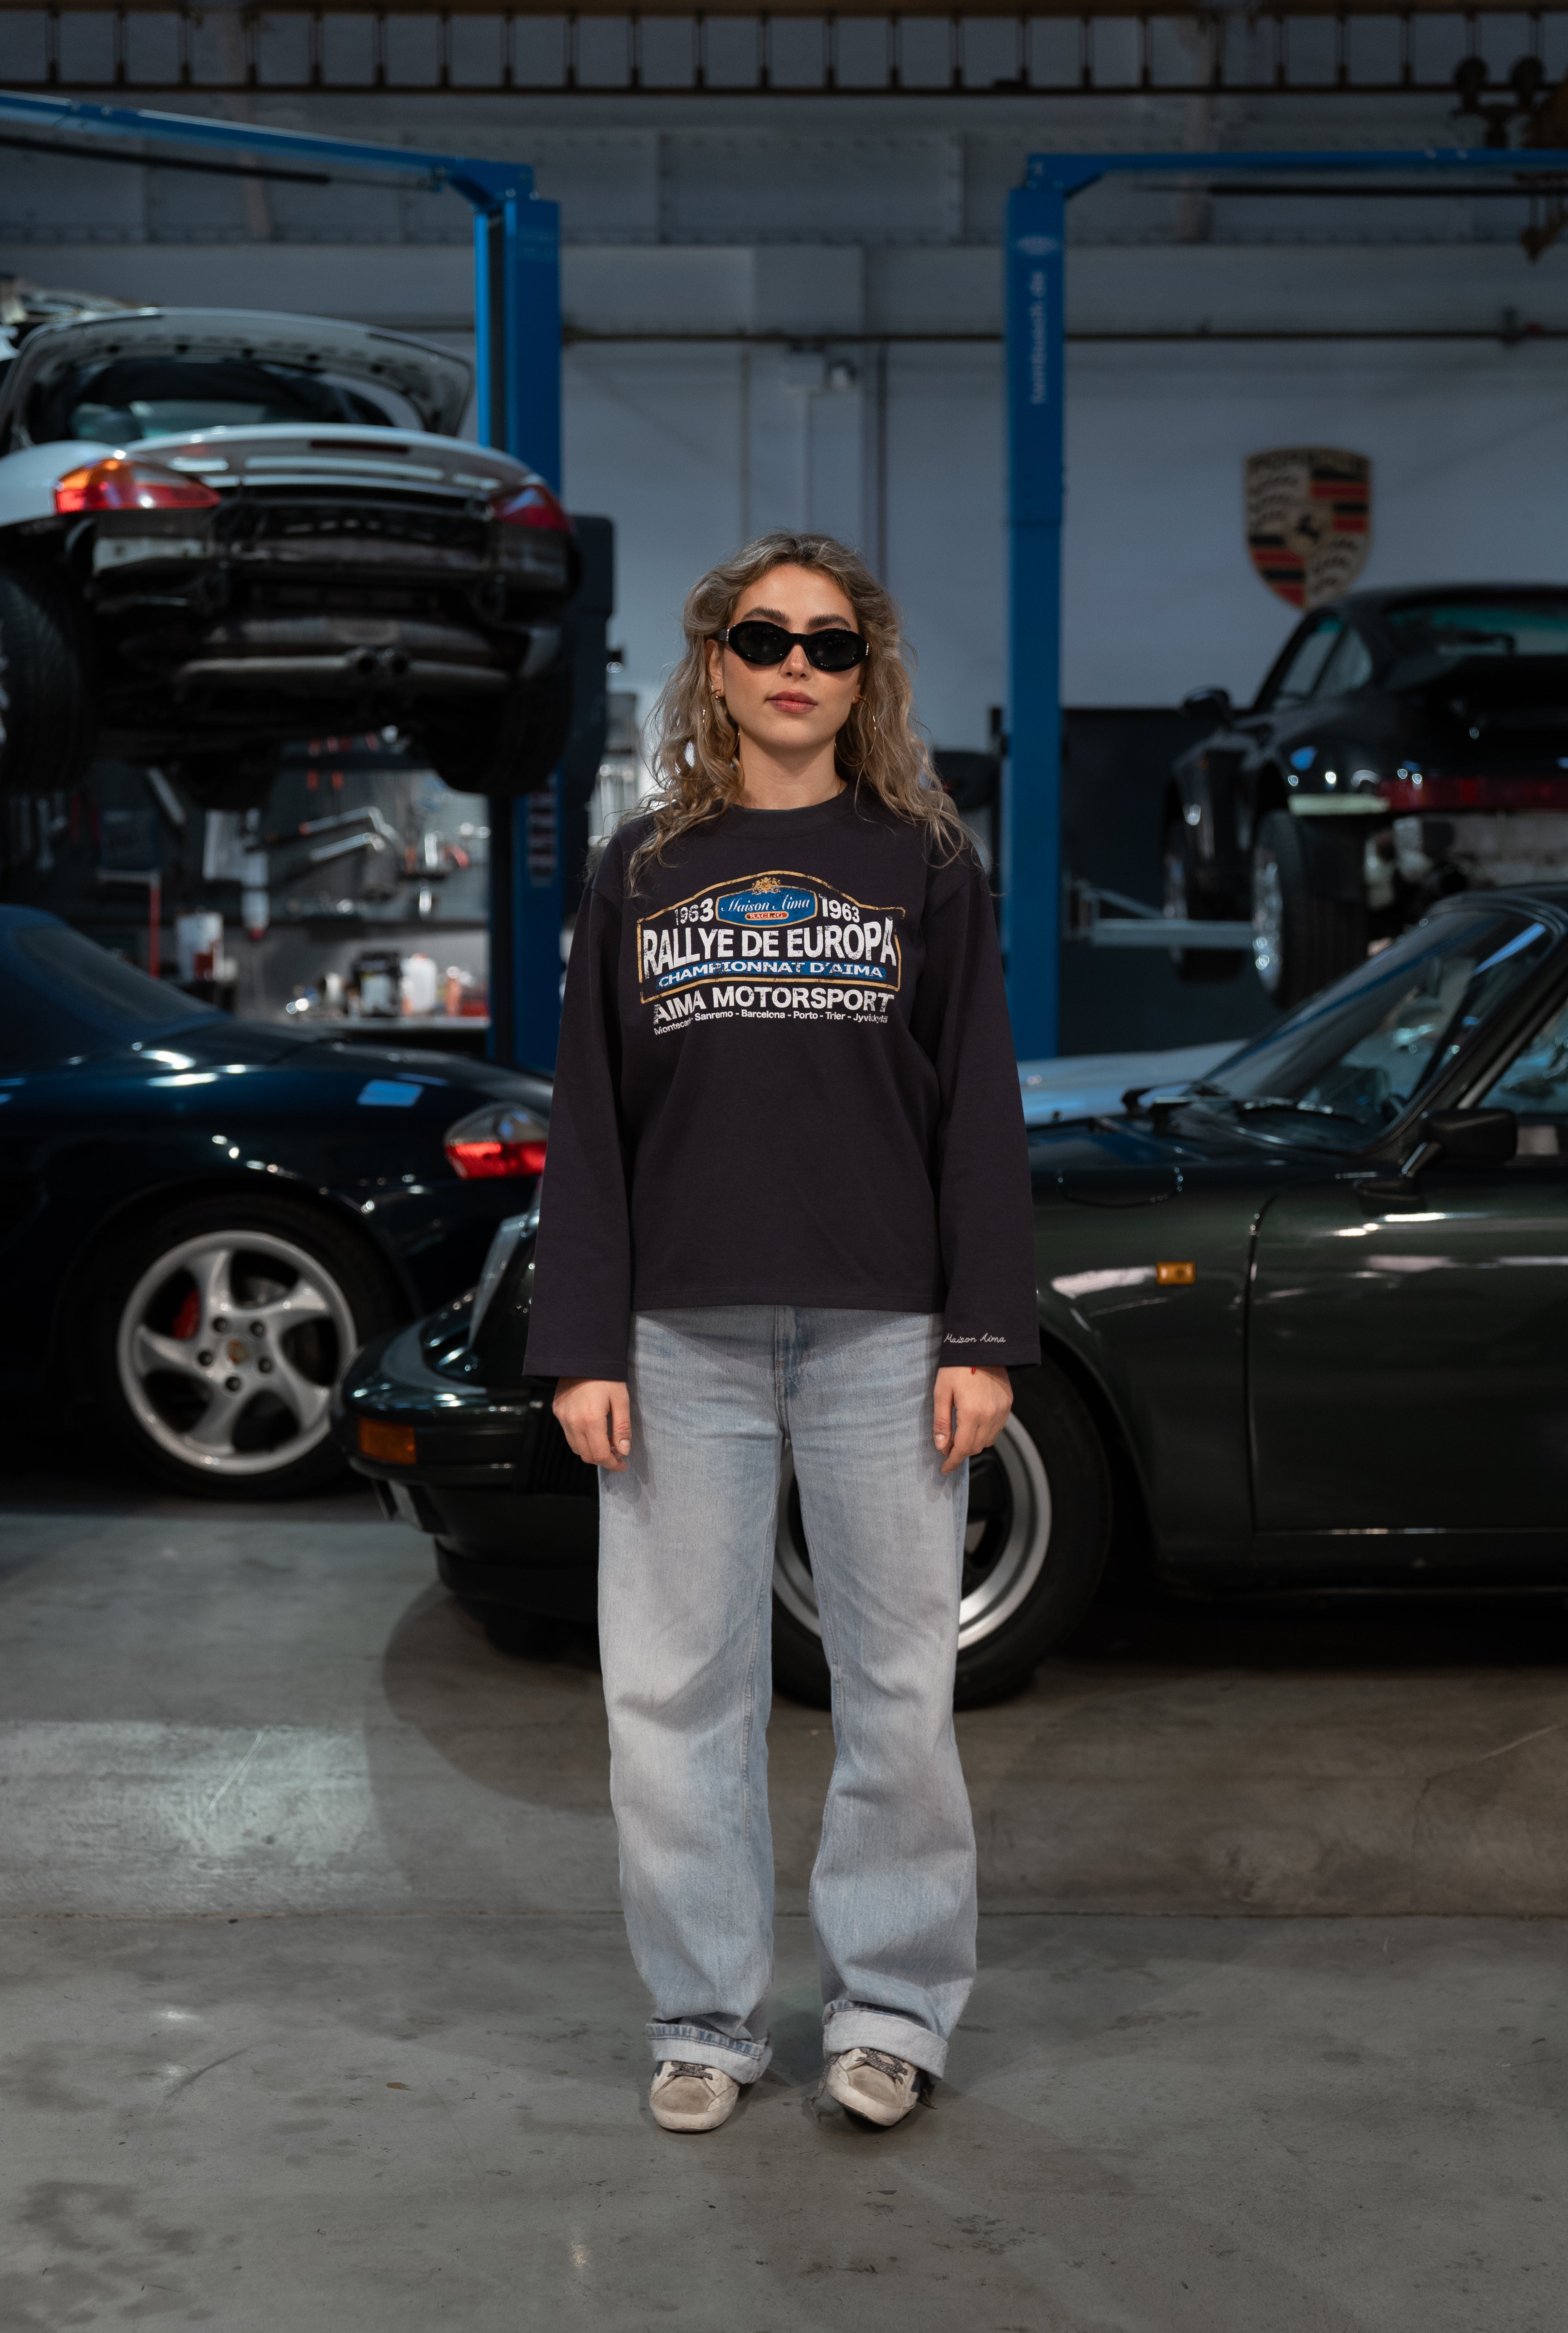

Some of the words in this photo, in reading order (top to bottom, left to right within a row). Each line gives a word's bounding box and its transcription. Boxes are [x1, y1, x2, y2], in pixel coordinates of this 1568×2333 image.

[674, 898, 714, 926] 1963
[721, 897, 770, 912] Maison
[772, 894, 810, 910] Aima
[818, 893, 860, 923] 1963
[643, 927, 734, 979] RALLYE
[741, 929, 779, 958] DE
[787, 916, 896, 966] EUROPA
[659, 961, 805, 987] CHAMPIONNAT
[810, 962, 883, 978] D'AIMA
[653, 989, 707, 1025] AIMA
[712, 985, 895, 1013] MOTORSPORT
[695, 1010, 733, 1021] Sanremo
[741, 1009, 785, 1018] Barcelona
[794, 1011, 818, 1020] Porto
[825, 1011, 846, 1020] Trier
[943, 1333, 977, 1344] Maison
[979, 1333, 1006, 1343] Aima
